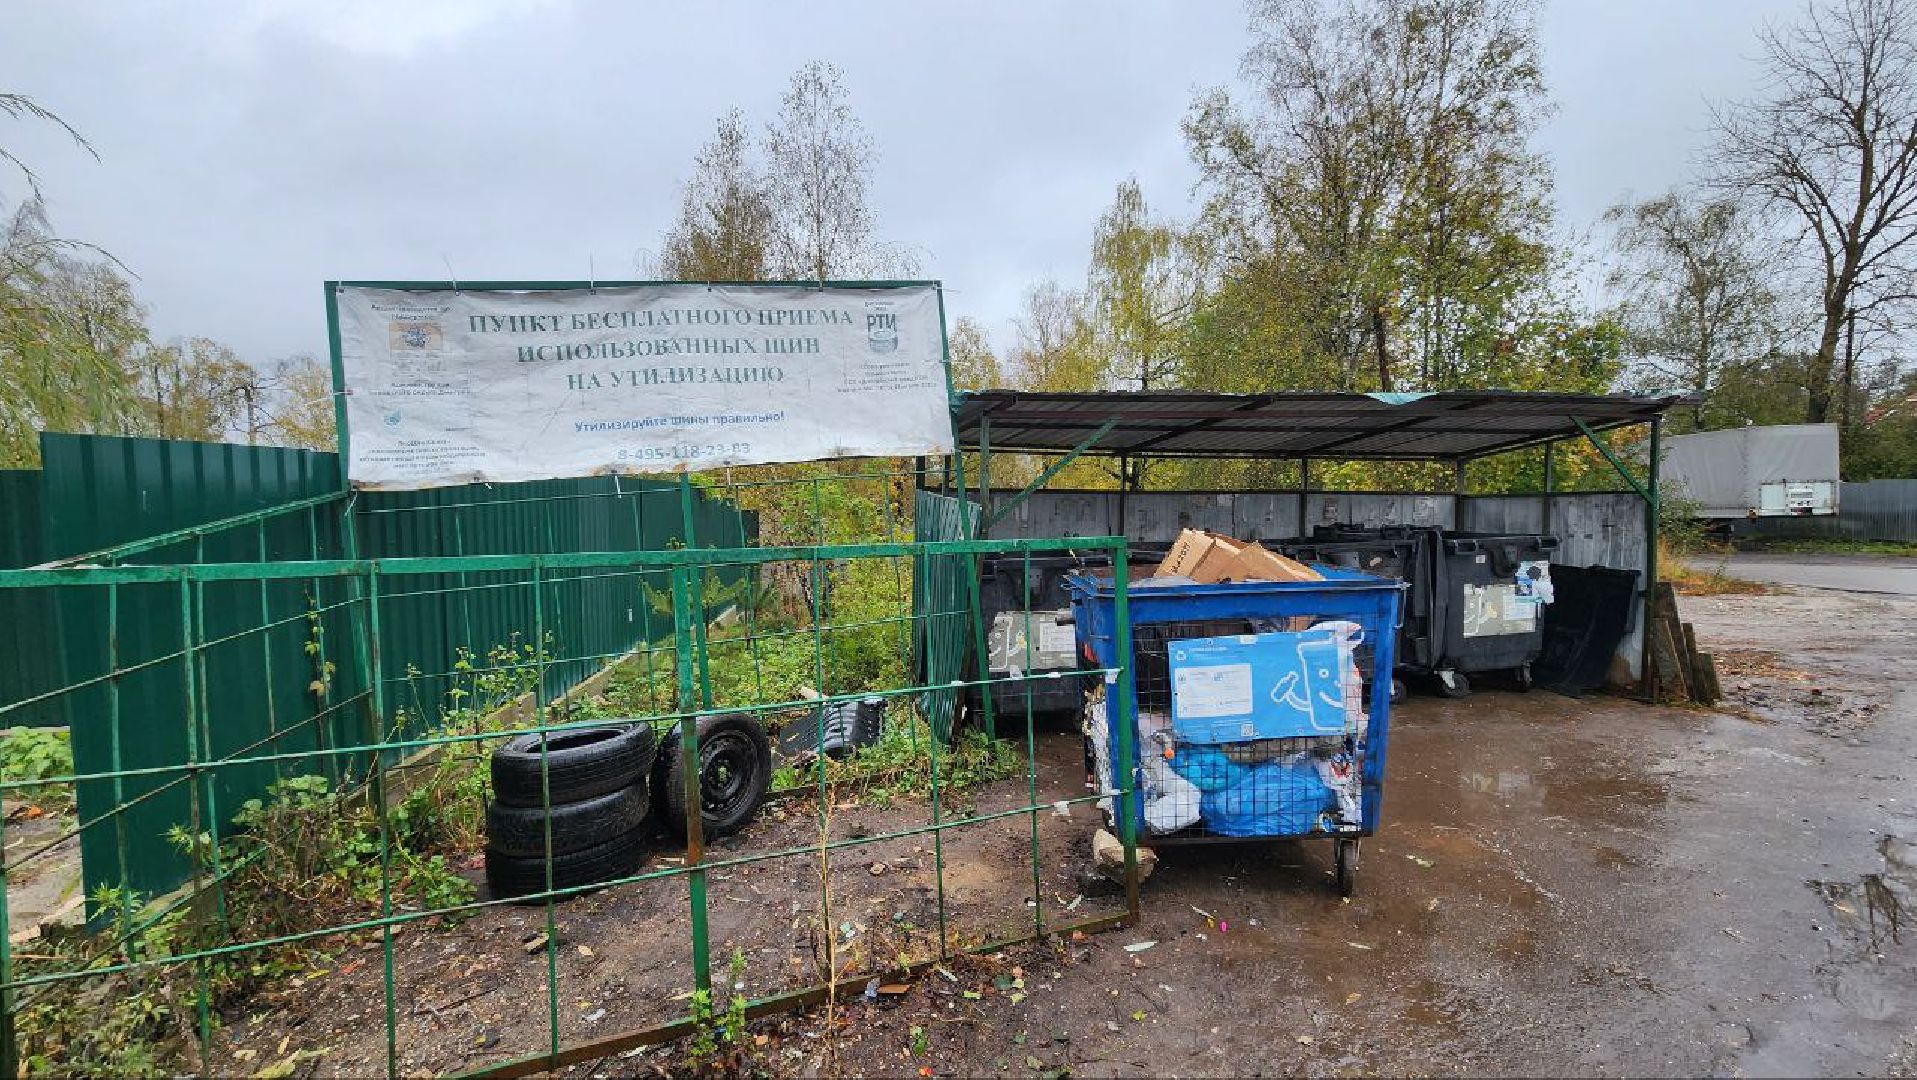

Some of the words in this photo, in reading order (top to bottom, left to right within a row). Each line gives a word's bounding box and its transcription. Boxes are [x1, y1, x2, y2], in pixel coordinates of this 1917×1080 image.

[469, 315, 563, 334] ПУНКТ
[571, 309, 752, 331] БЕСПЛАТНОГО
[758, 309, 854, 326] ПРИЕМА
[517, 337, 757, 363] ИСПОЛЬЗОВАННЫХ
[765, 337, 820, 354] ШИН
[566, 371, 602, 390] НА
[610, 366, 785, 388] УТИЛИЗАЦИЮ
[574, 416, 667, 433] Утилизируйте
[712, 410, 785, 427] правильно!
